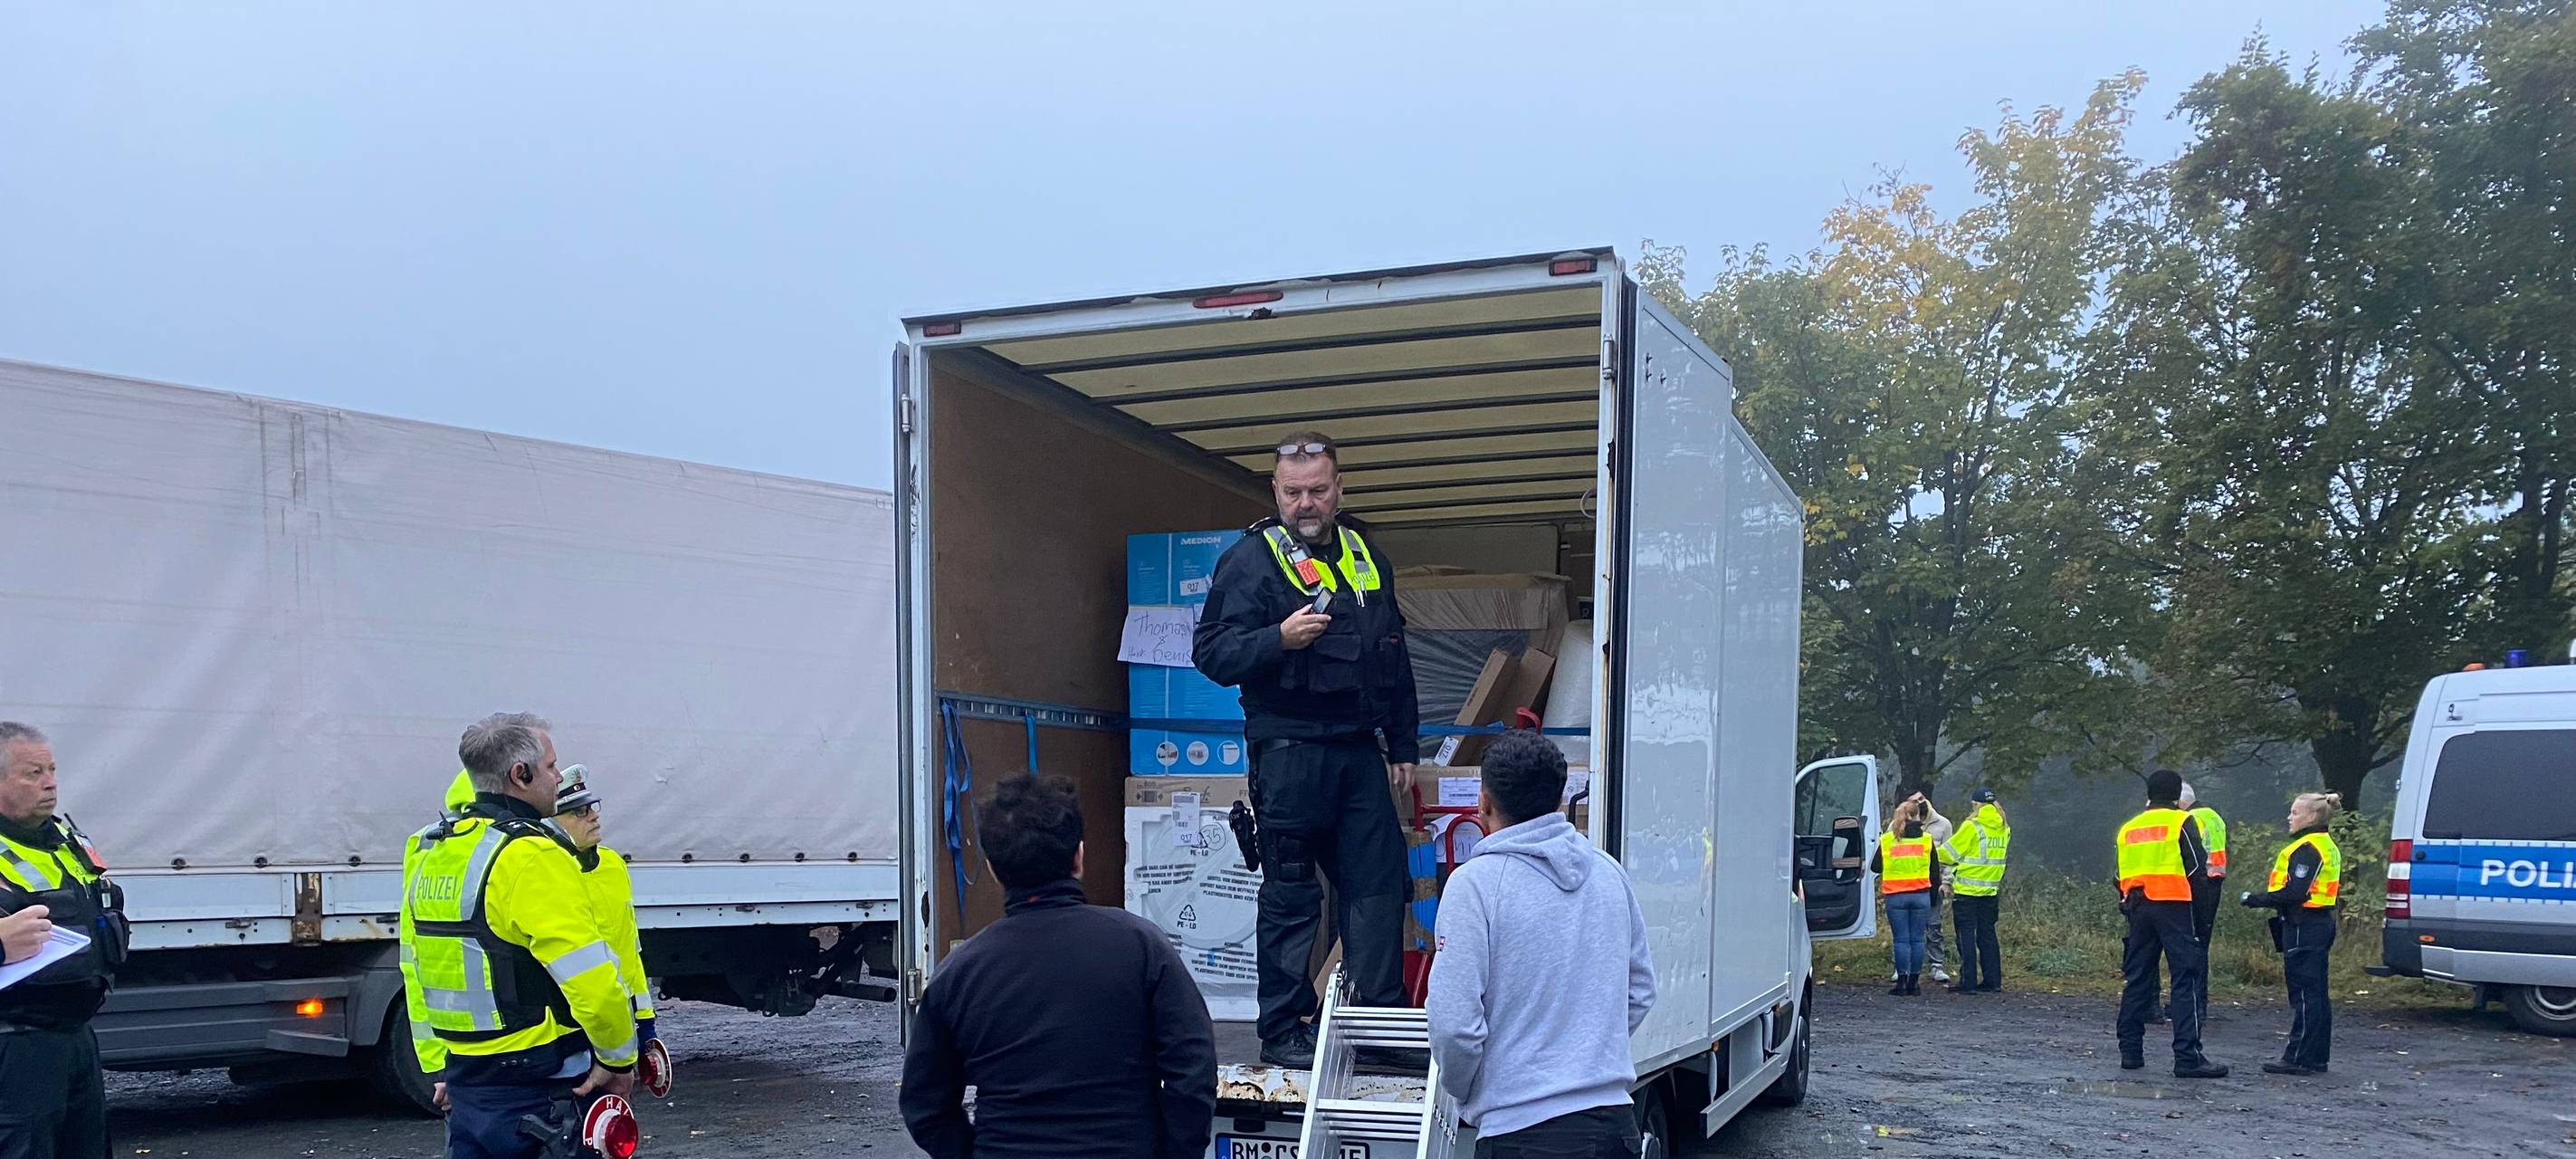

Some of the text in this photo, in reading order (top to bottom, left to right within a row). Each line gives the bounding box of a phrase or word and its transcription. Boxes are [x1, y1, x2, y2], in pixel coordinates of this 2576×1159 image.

[1181, 536, 1221, 545] MEDION
[1987, 837, 2006, 849] ZOLL
[2480, 859, 2576, 889] POLI
[416, 876, 458, 901] POLIZEI
[1232, 1142, 1259, 1159] BM
